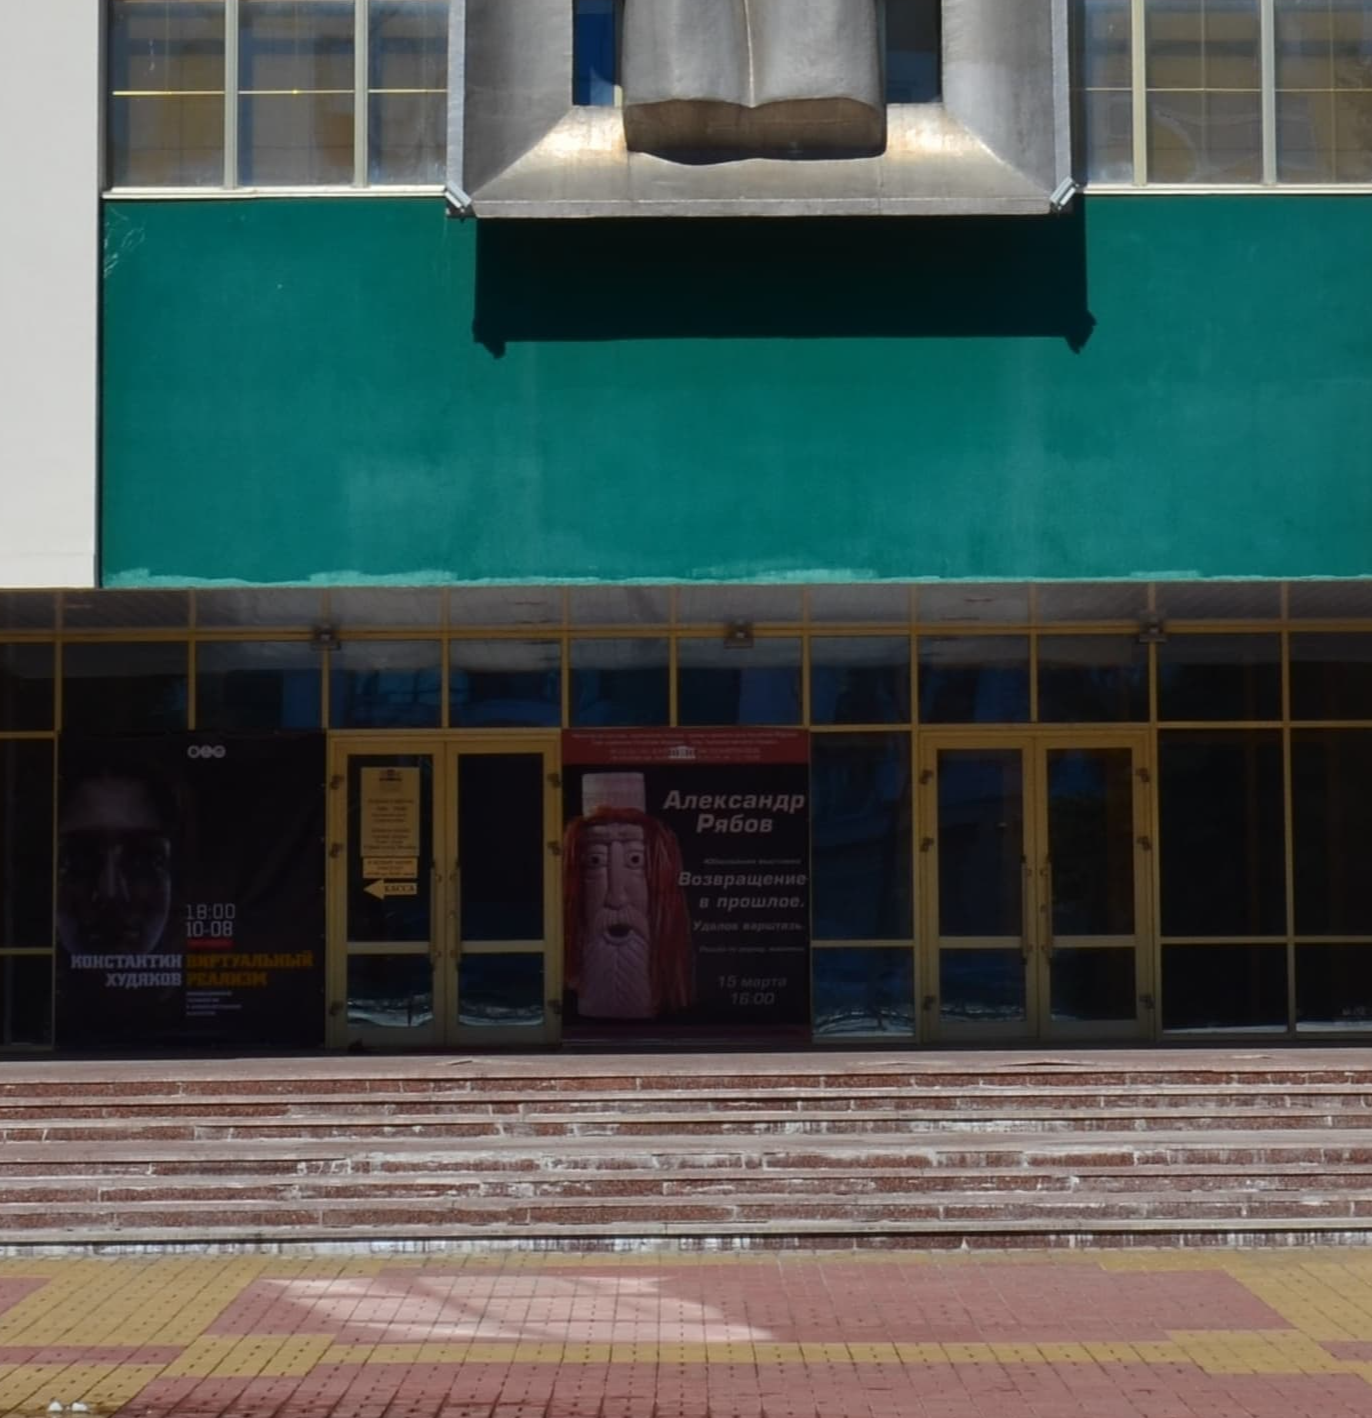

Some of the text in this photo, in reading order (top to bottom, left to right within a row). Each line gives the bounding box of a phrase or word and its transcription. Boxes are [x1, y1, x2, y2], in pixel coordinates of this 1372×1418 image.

[662, 789, 806, 815] Александр
[695, 813, 773, 834] Рябов
[678, 871, 808, 890] Возвращение
[186, 903, 236, 920] 18:00
[699, 896, 805, 913] в прошлое.
[186, 920, 234, 938] 10-08
[70, 954, 183, 970] КОНСТАНТИН
[185, 949, 314, 969] ВИРТУАЛЬНЫЙ
[105, 971, 183, 990] ХУДЯКОВ
[185, 971, 269, 988] РЕАЛИЗМ
